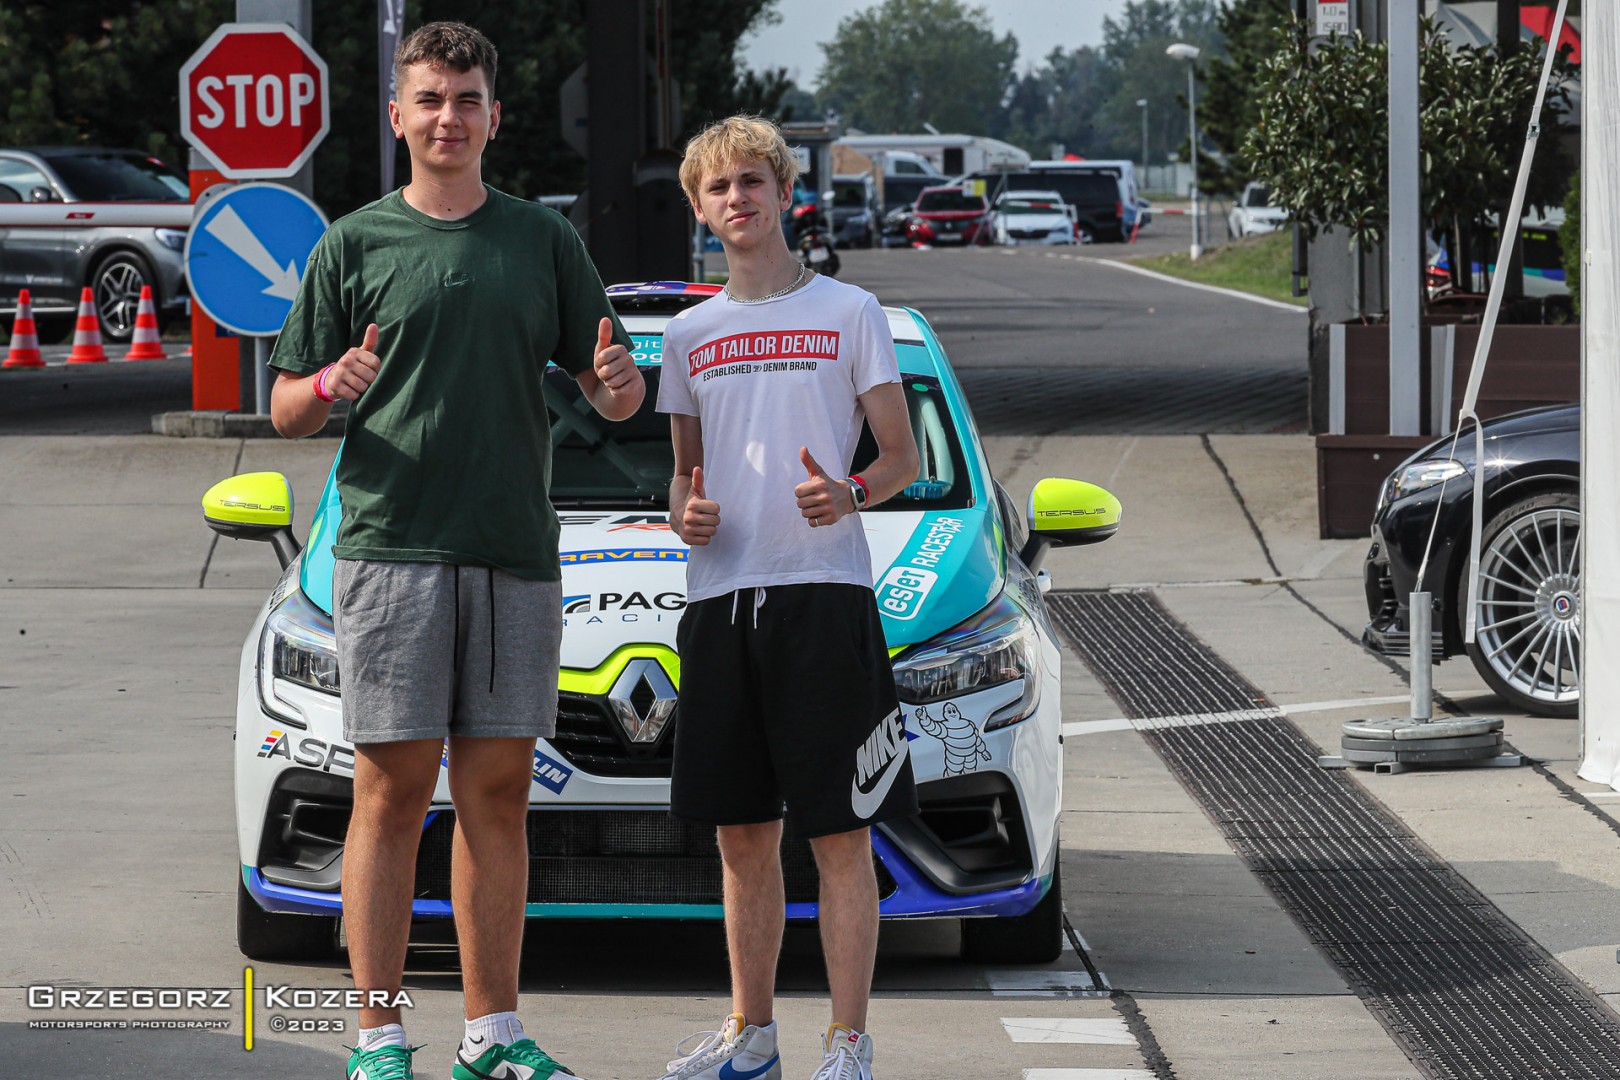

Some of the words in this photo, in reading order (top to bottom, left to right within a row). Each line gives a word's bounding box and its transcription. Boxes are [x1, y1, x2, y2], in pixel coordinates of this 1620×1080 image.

[197, 73, 315, 129] STOP
[690, 344, 716, 373] TOM
[720, 335, 776, 360] TAILOR
[781, 334, 837, 355] DENIM
[703, 364, 752, 382] ESTABLISHED
[763, 362, 788, 373] DENIM
[790, 361, 817, 371] BRAND
[219, 499, 286, 512] TERSUS
[1037, 508, 1106, 517] TERSUS
[599, 591, 688, 611] PAG
[856, 706, 906, 787] NIKE
